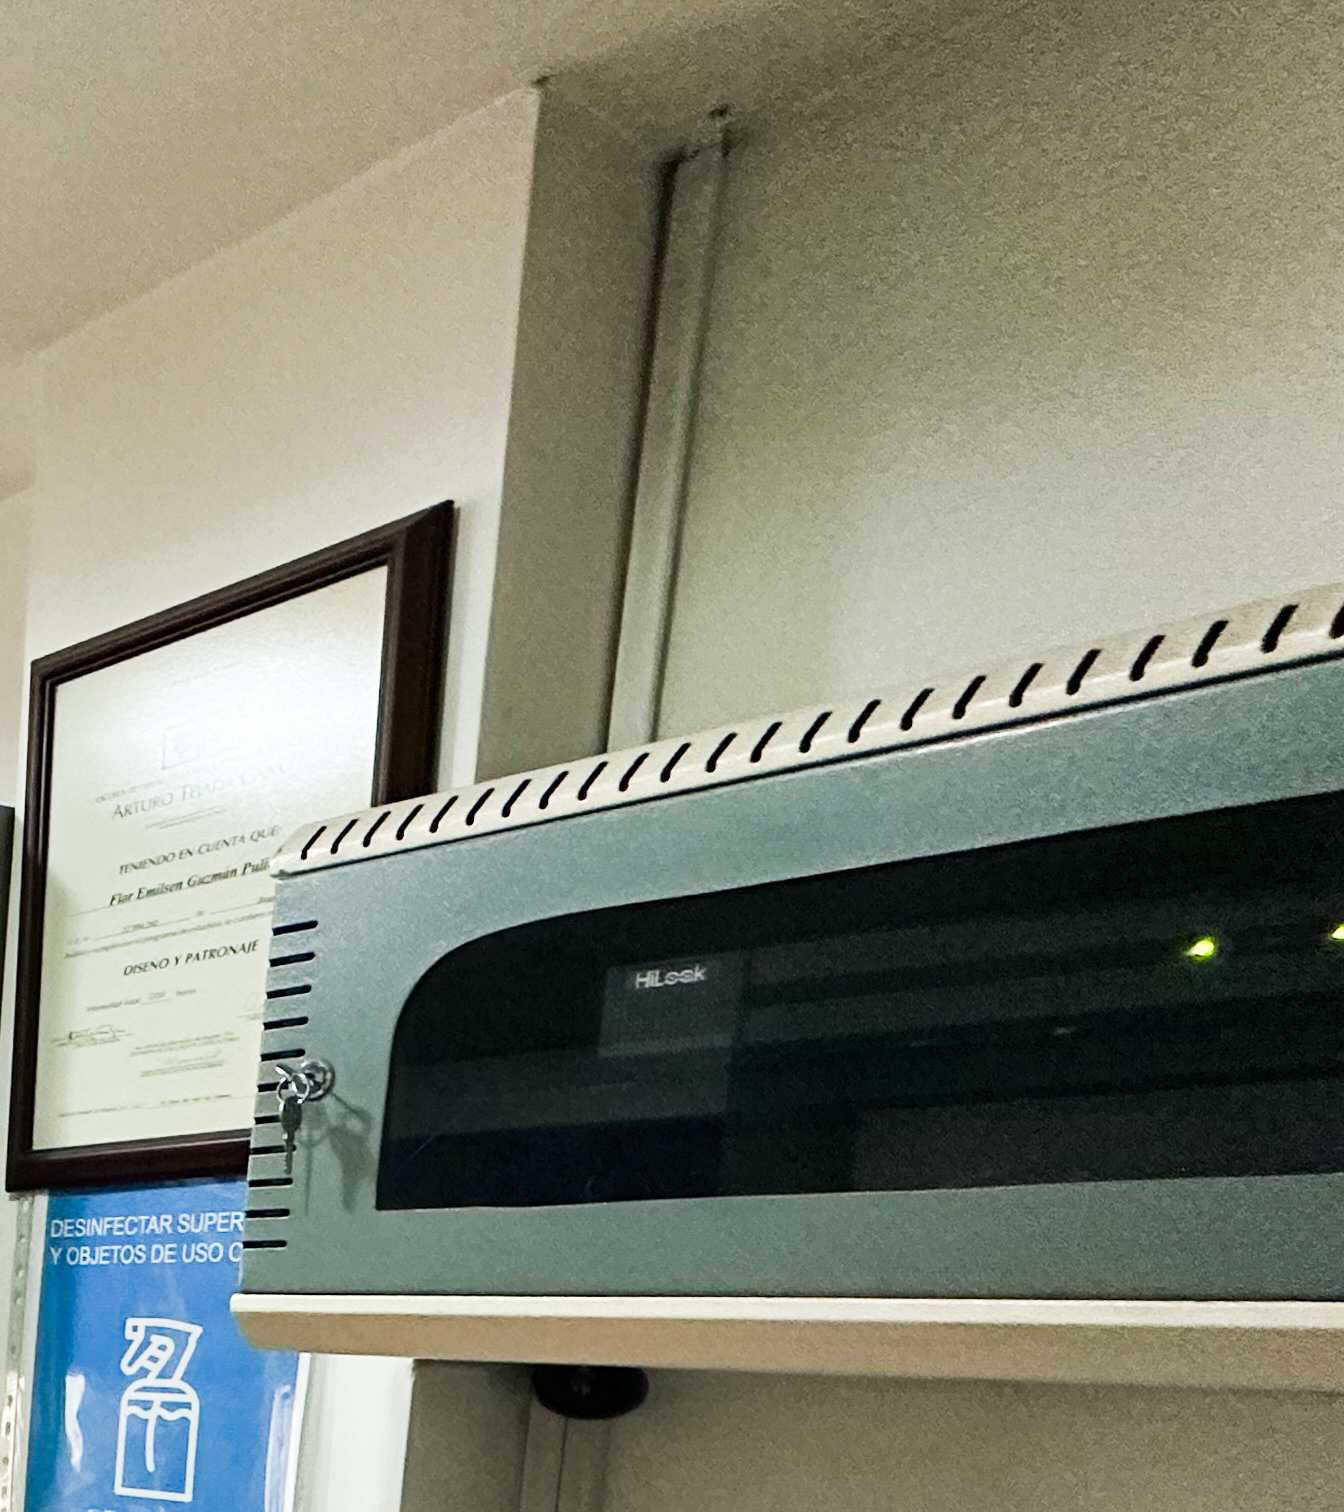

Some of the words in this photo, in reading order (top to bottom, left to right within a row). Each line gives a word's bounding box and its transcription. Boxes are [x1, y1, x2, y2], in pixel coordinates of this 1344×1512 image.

[119, 852, 175, 875] TENIENDO
[179, 848, 194, 860] EN
[198, 834, 245, 855] CUENTA
[137, 879, 183, 901] Emilsen
[174, 956, 183, 966] Y
[185, 939, 260, 964] PATRONAJE
[635, 965, 708, 989] HiLook
[50, 1214, 173, 1238] DESINFECTAR
[177, 1211, 245, 1234] SUPER
[50, 1248, 62, 1265] Y
[66, 1245, 146, 1265] OBJETOS
[151, 1244, 177, 1264] DE
[182, 1242, 224, 1263] USO
